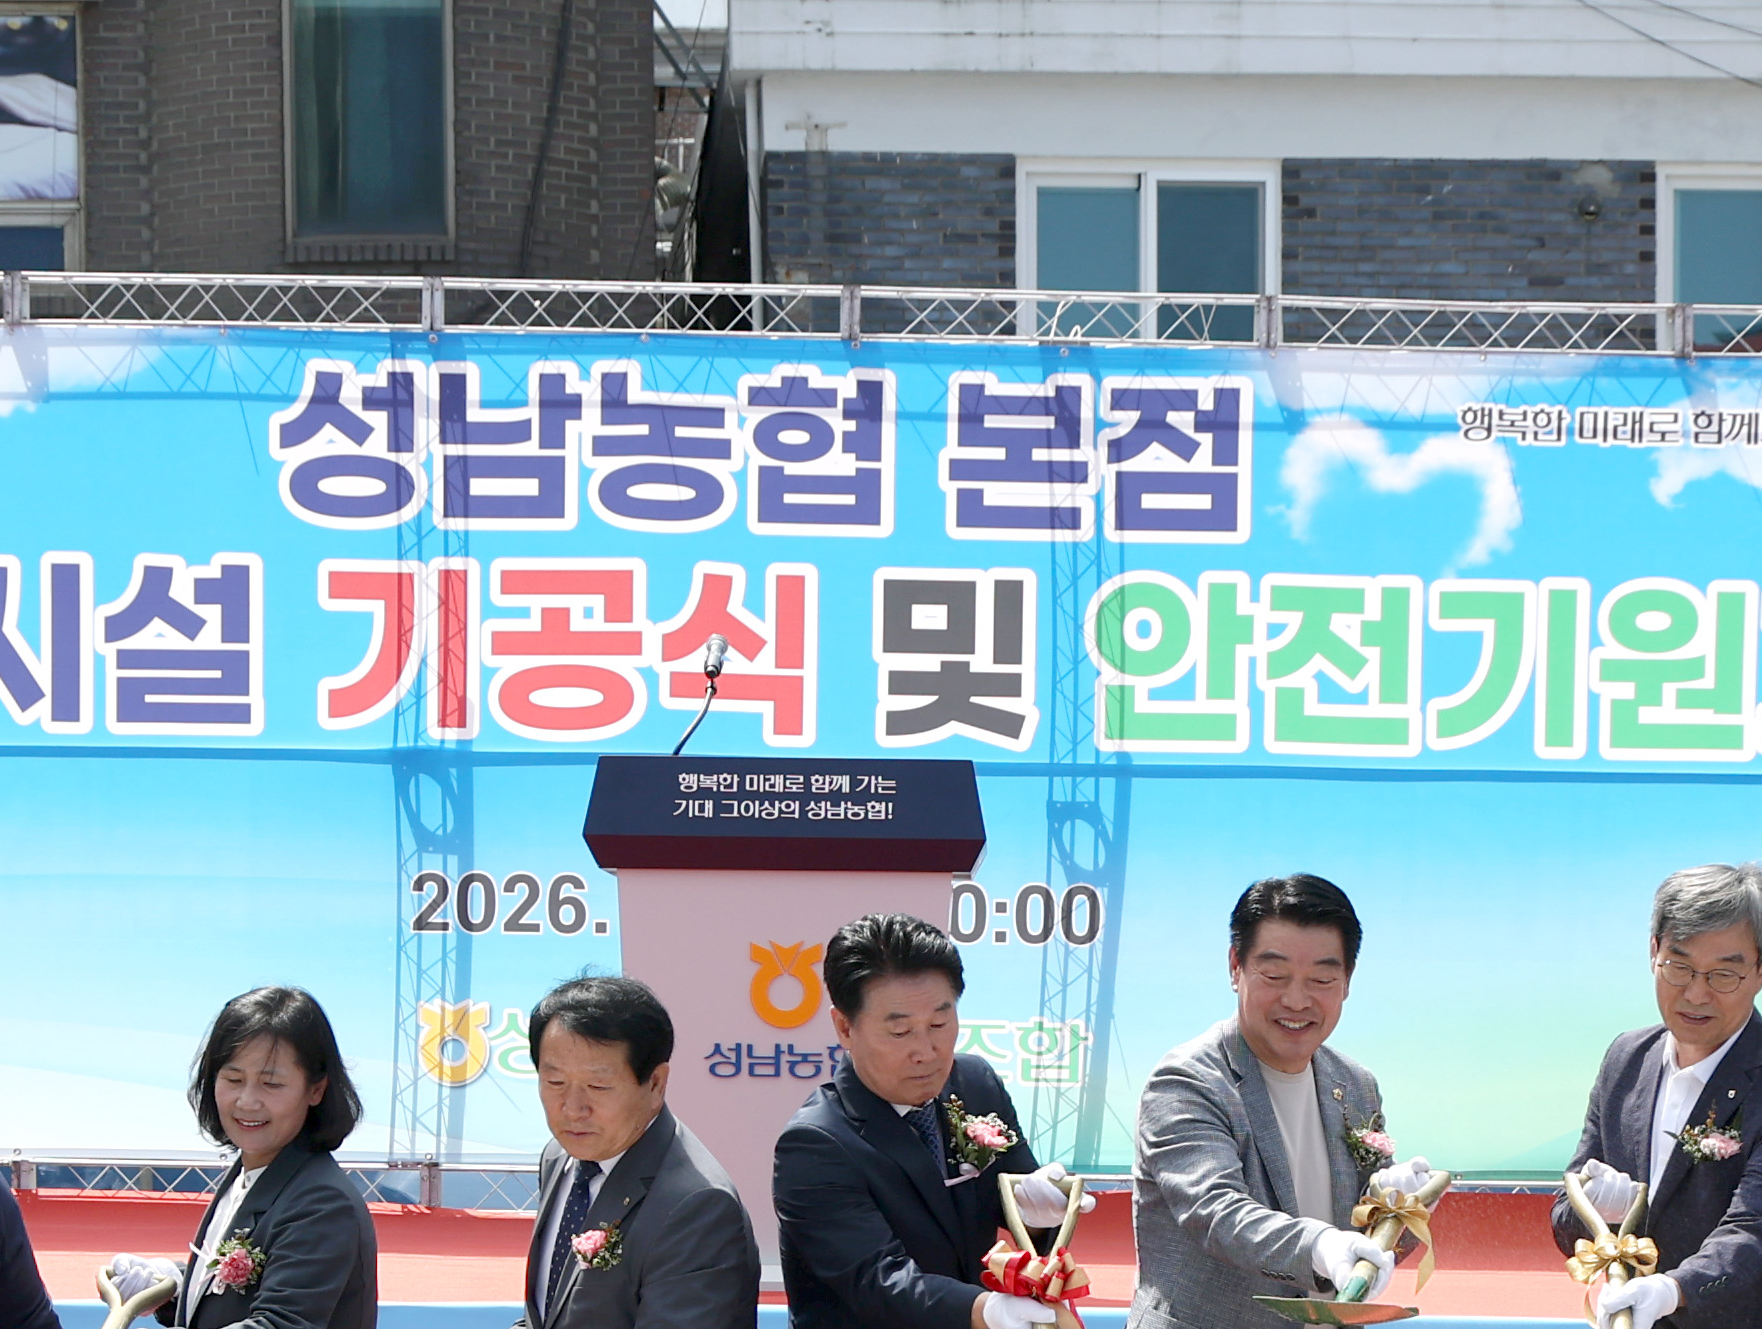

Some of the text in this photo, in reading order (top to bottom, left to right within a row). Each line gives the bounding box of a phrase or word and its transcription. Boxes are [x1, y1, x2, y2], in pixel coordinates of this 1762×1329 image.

[1460, 405, 1566, 446] 행복한
[1578, 406, 1679, 446] 미래로
[279, 370, 1237, 534] 성남농협 본점
[328, 567, 806, 737] 기공식
[883, 577, 1028, 740] 및
[678, 773, 897, 794] 행복한 미래로 함께 가는
[672, 799, 714, 818] 기대
[805, 800, 894, 820] 성남농협!
[411, 873, 609, 935] 2026.
